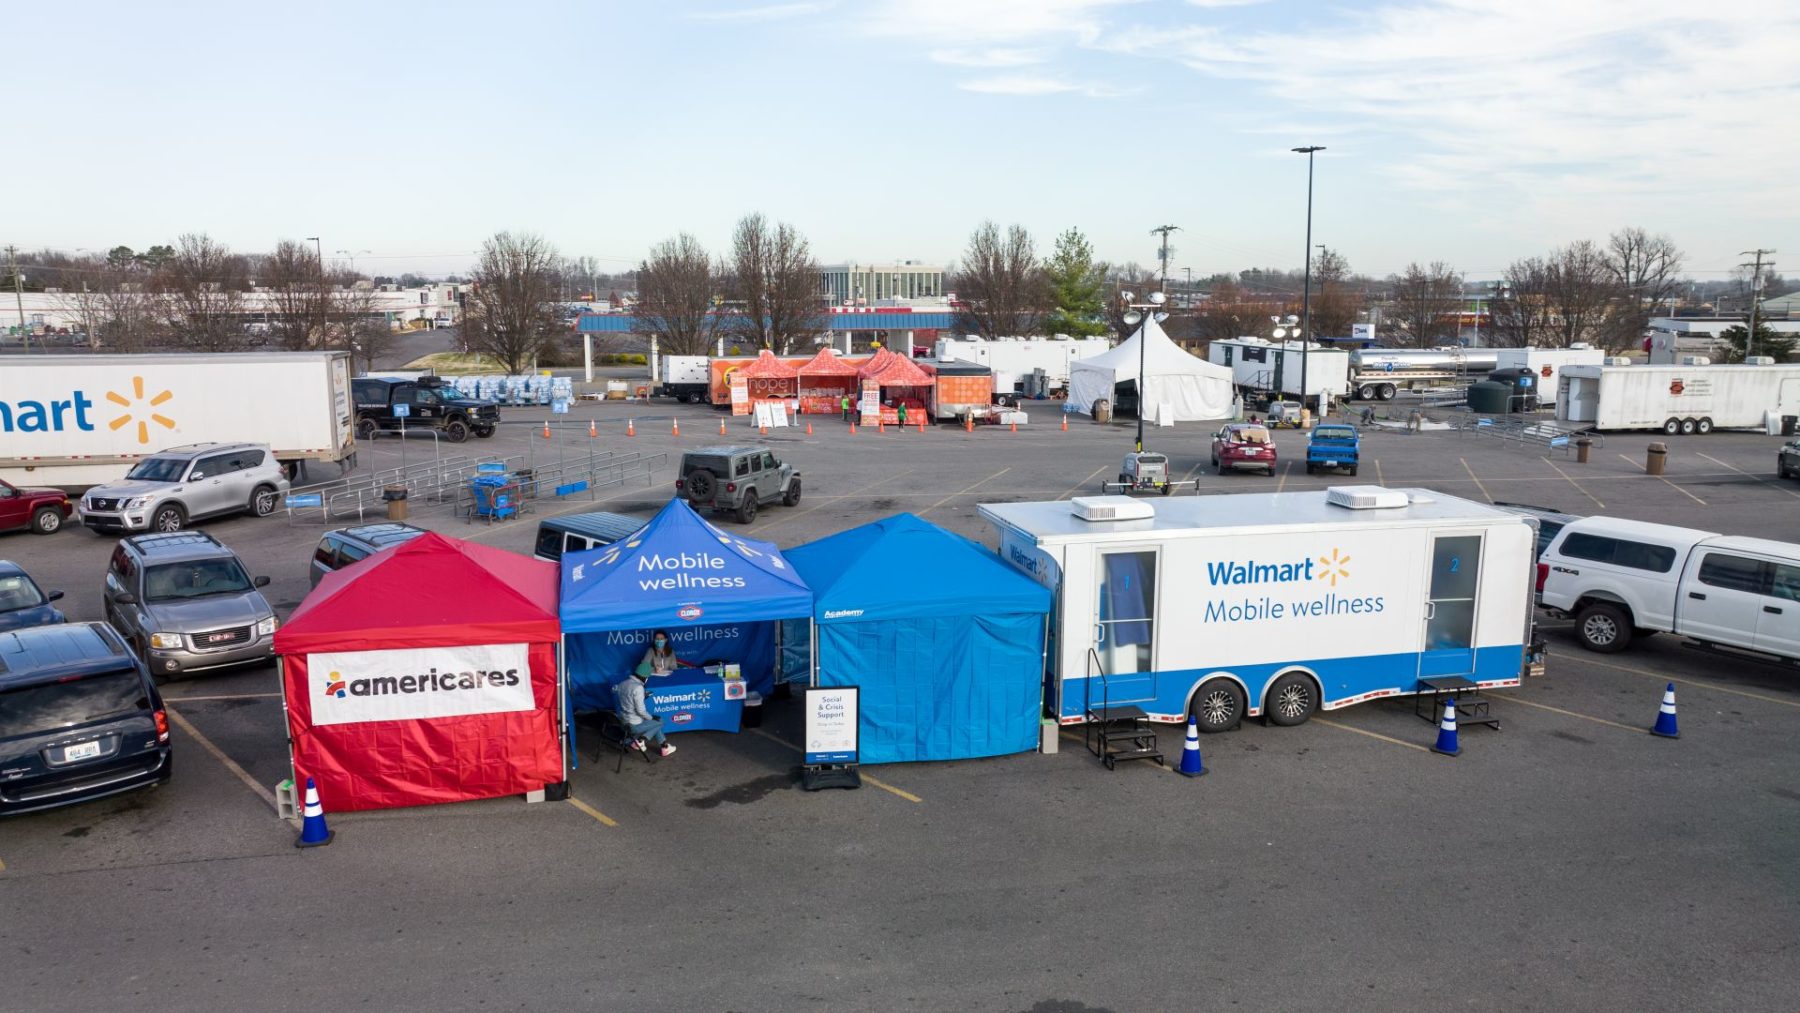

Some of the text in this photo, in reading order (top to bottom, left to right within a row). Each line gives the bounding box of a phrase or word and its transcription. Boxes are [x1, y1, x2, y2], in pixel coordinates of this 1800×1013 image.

[864, 392, 879, 400] FREE
[638, 553, 725, 572] Mobile
[1010, 544, 1037, 574] Walmart
[1450, 558, 1460, 572] 2
[1207, 557, 1314, 586] Walmart
[639, 573, 746, 591] wellness
[824, 609, 865, 618] Academy
[1204, 593, 1384, 624] Mobile wellness
[607, 626, 739, 645] Mobil wellness
[350, 668, 520, 697] americares
[653, 692, 696, 705] Walmart
[653, 702, 710, 713] Mobile wellness
[817, 711, 844, 719] Support
